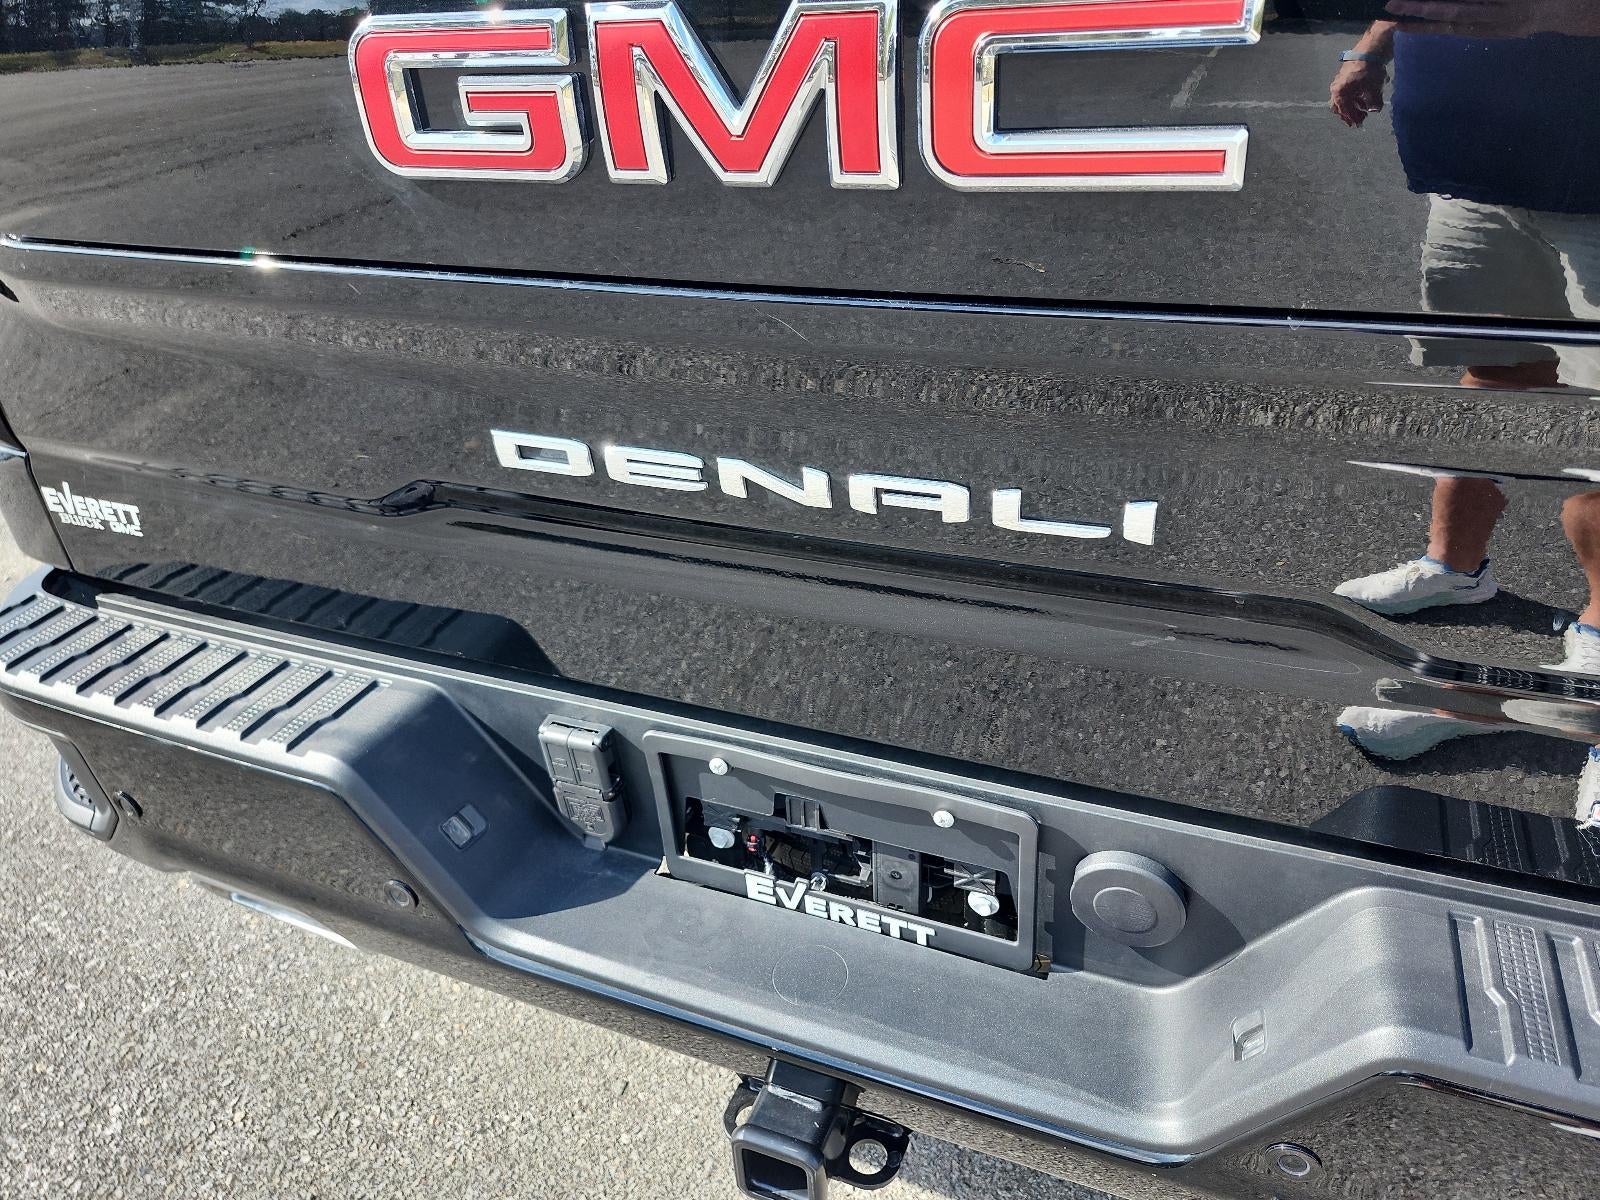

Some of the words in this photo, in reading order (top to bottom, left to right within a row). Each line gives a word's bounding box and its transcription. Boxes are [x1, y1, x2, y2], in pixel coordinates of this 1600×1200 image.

[348, 0, 1263, 192] GMC
[40, 481, 141, 526] EVERETT
[58, 512, 105, 531] BUICK
[109, 521, 144, 537] GMC
[490, 429, 1158, 546] DENALI
[744, 870, 936, 946] EVERETT
